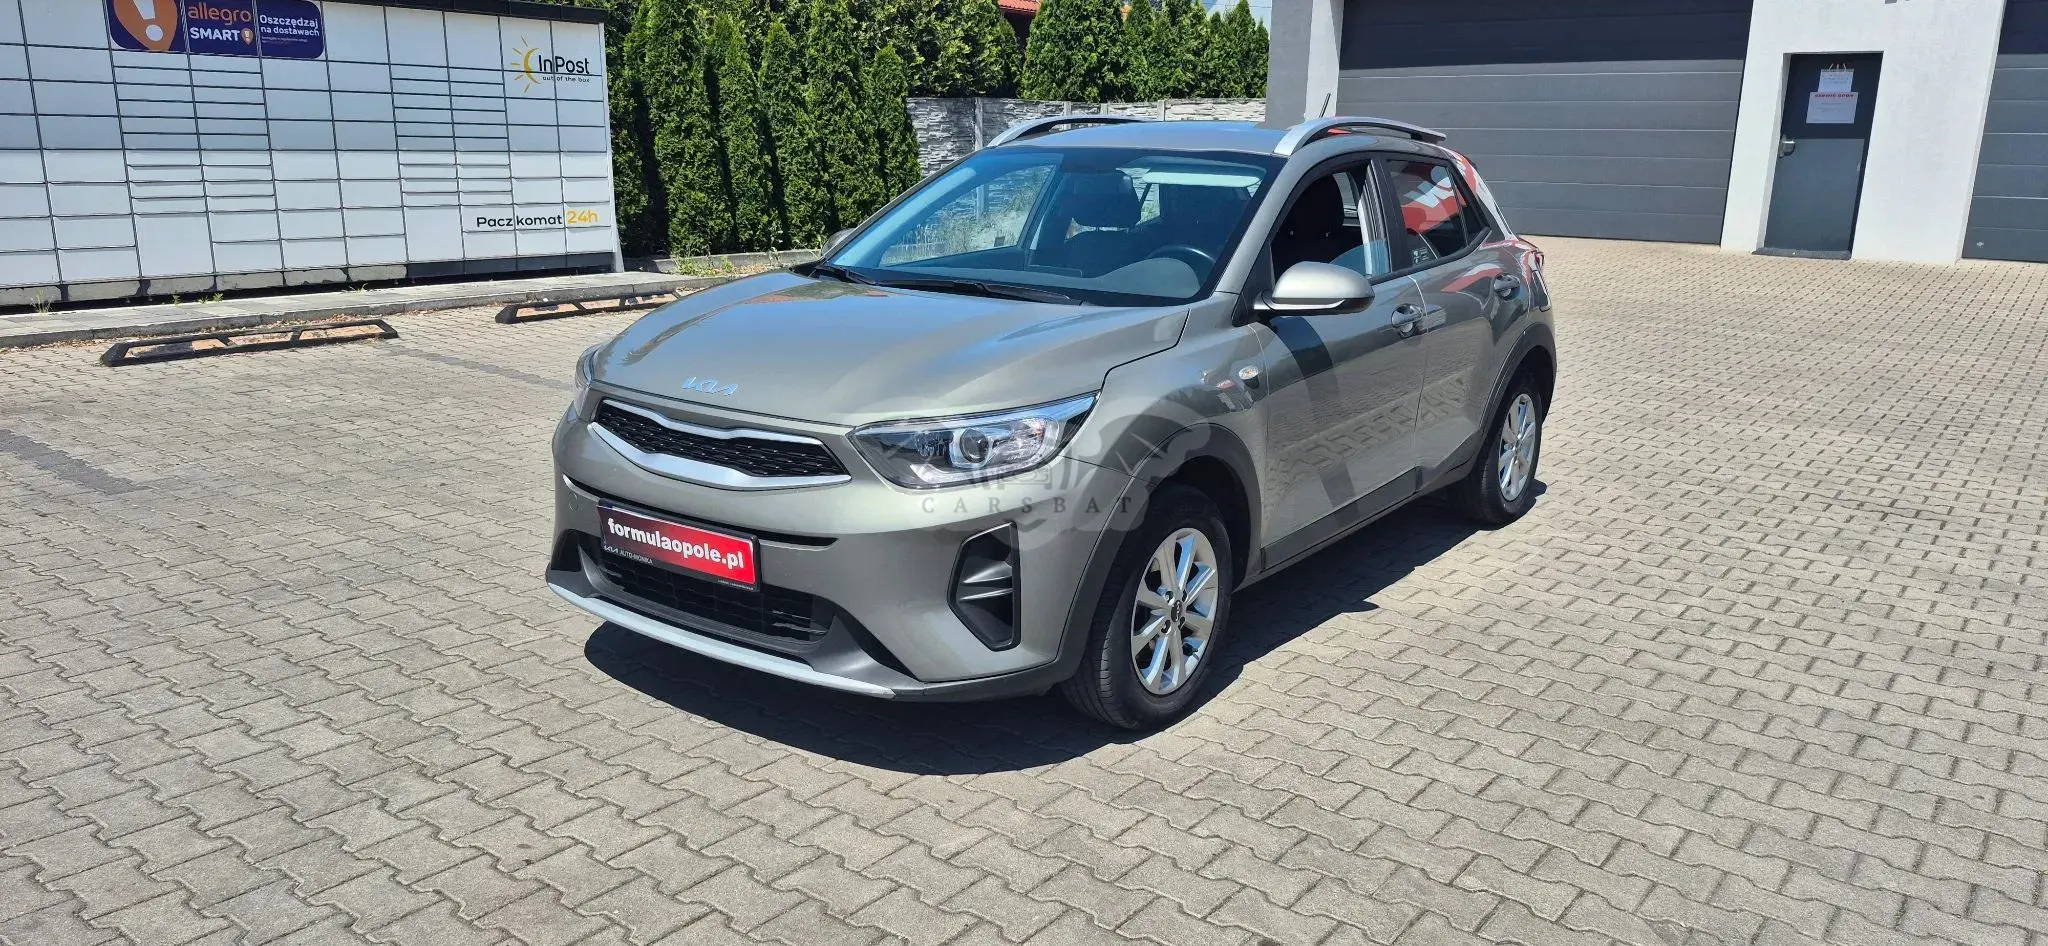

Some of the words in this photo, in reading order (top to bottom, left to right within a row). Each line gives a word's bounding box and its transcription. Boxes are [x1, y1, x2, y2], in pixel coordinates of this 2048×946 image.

[188, 2, 252, 26] allegro
[260, 14, 318, 29] Oszczędzaj
[273, 25, 320, 36] dostawach
[538, 54, 590, 74] InPost
[567, 209, 598, 224] 24h
[607, 517, 744, 570] formulaopole.pl
